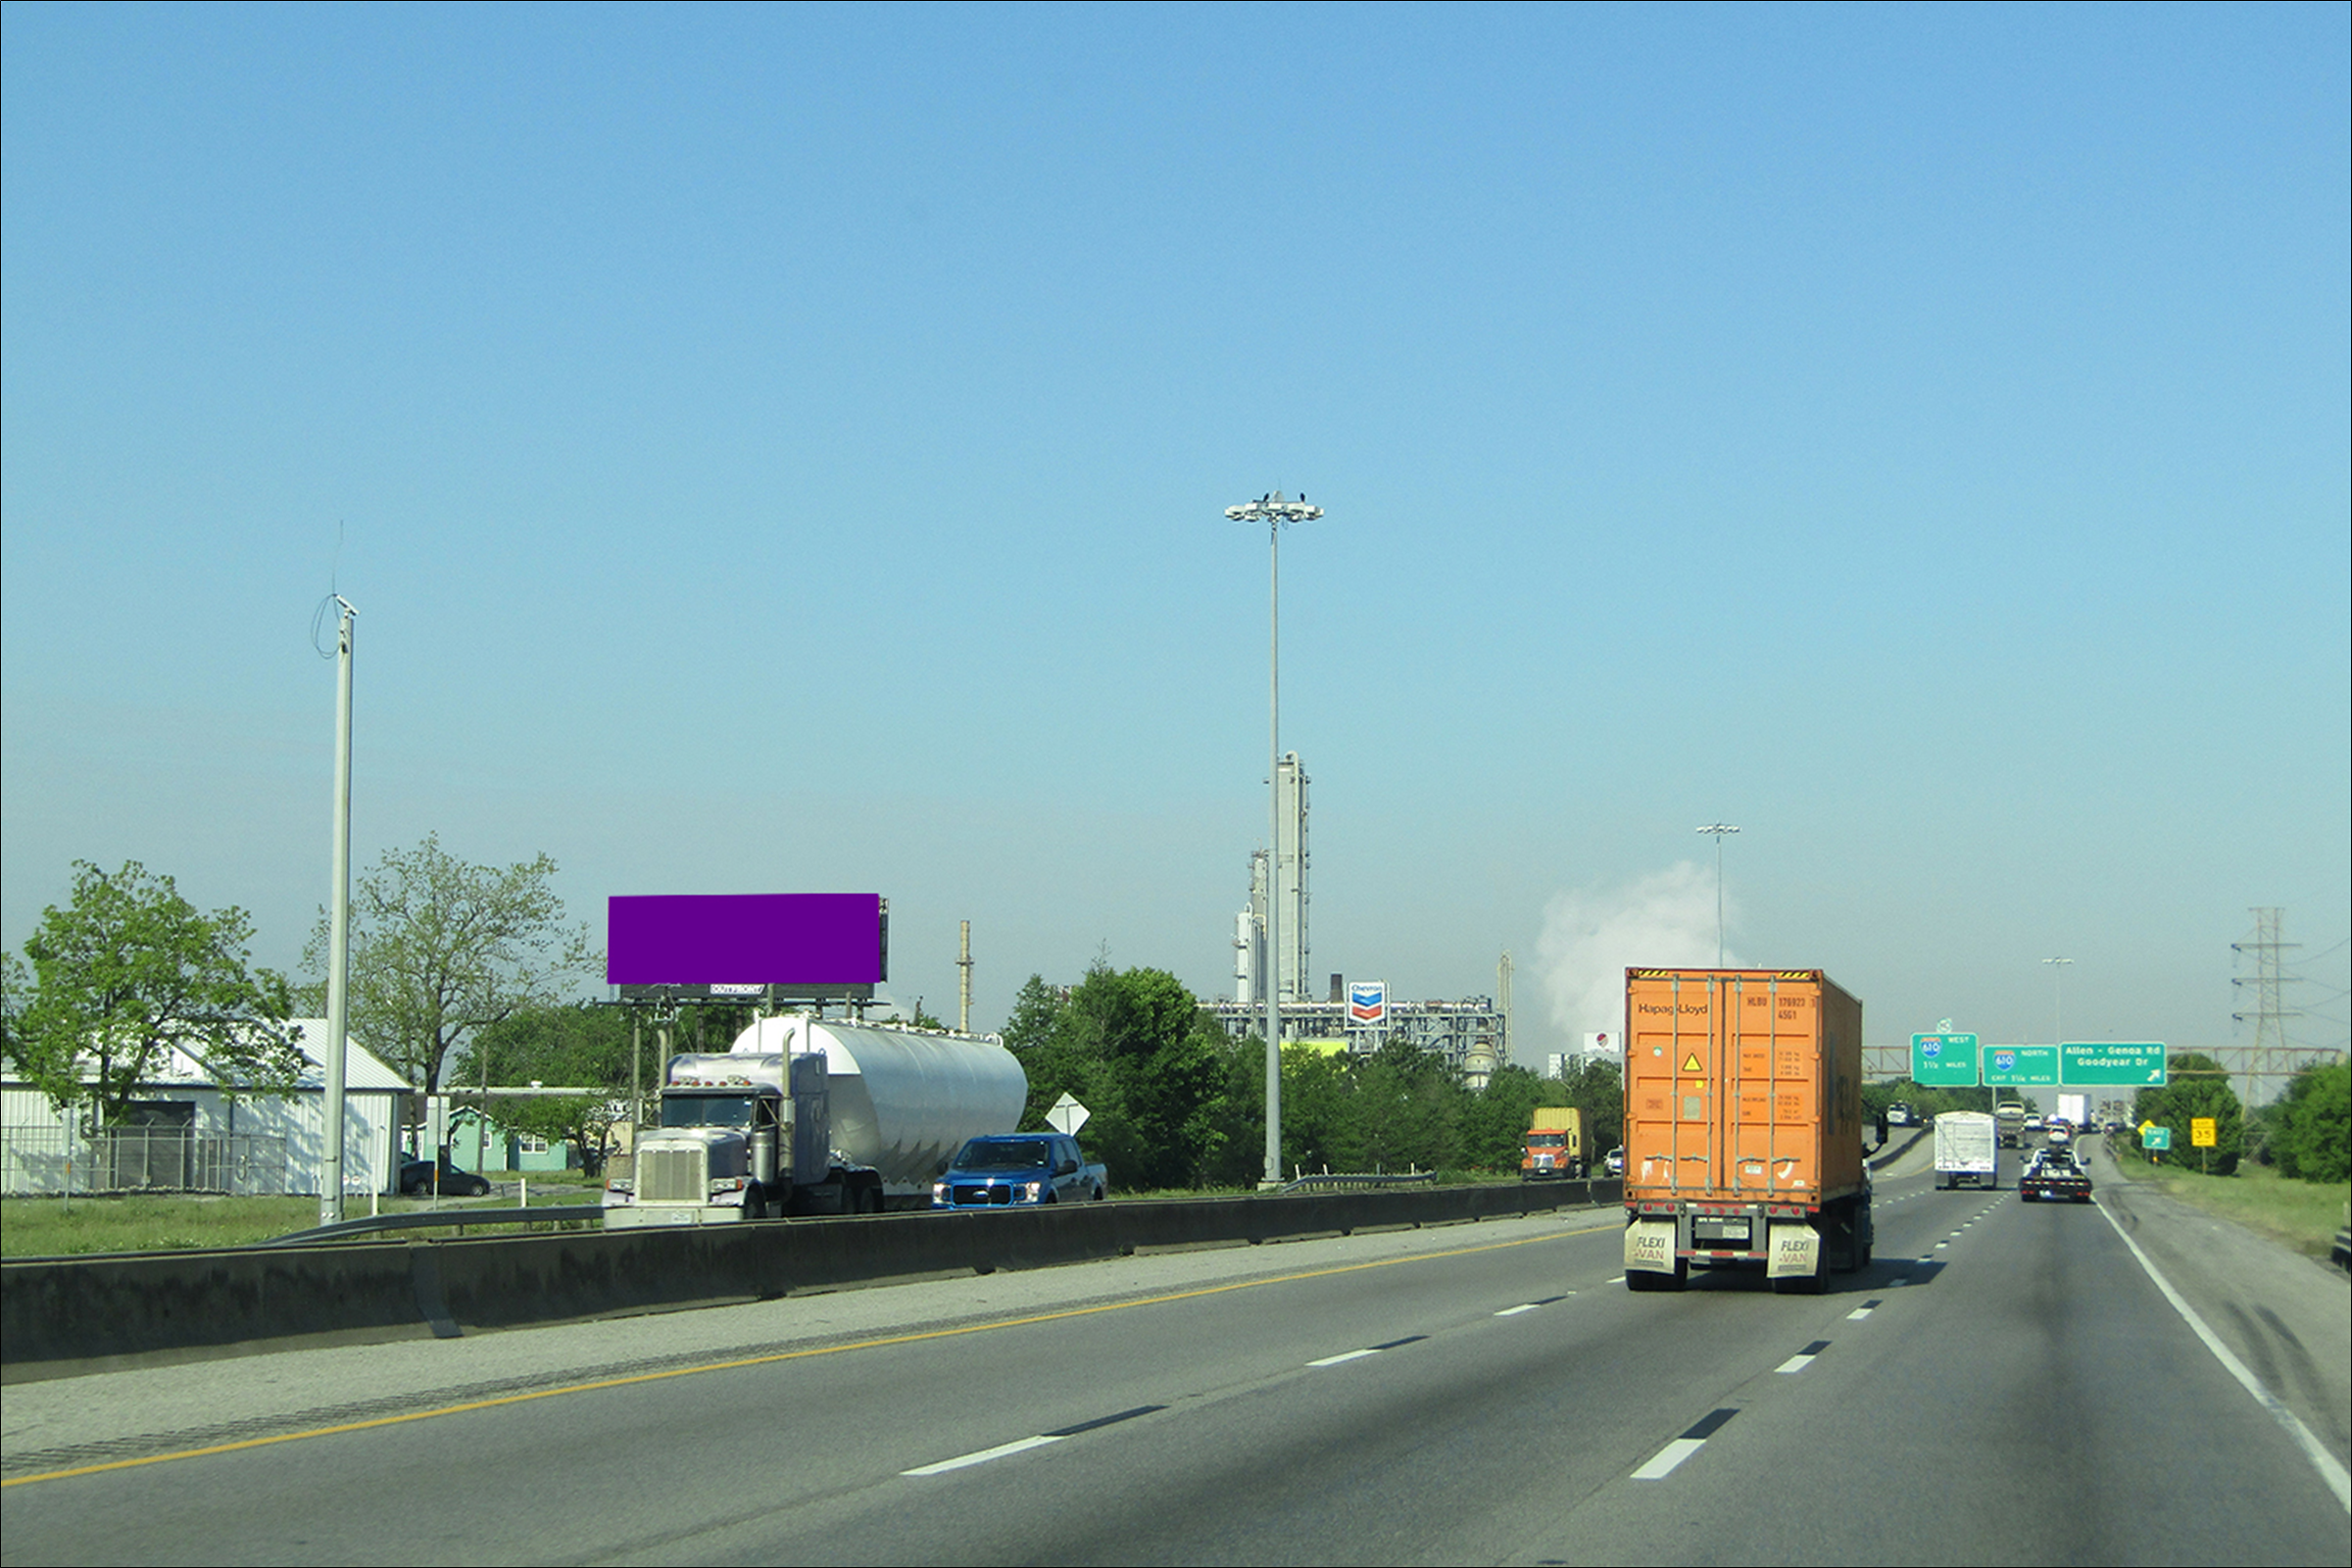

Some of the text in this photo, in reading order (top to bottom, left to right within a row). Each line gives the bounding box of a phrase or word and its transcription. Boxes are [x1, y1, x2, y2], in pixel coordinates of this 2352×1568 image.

[1639, 1004, 1708, 1016] Hapag-Lloyd
[1922, 1042, 1940, 1052] 610
[2066, 1046, 2093, 1054] Allen
[2107, 1046, 2142, 1054] Genoa
[2146, 1046, 2161, 1054] Rd
[1995, 1055, 2012, 1065] 610
[2077, 1057, 2148, 1067] Goodyear Dr
[2195, 1130, 2211, 1139] 35
[1637, 1237, 1666, 1249] FLEXI
[1781, 1240, 1810, 1251] FLEXI
